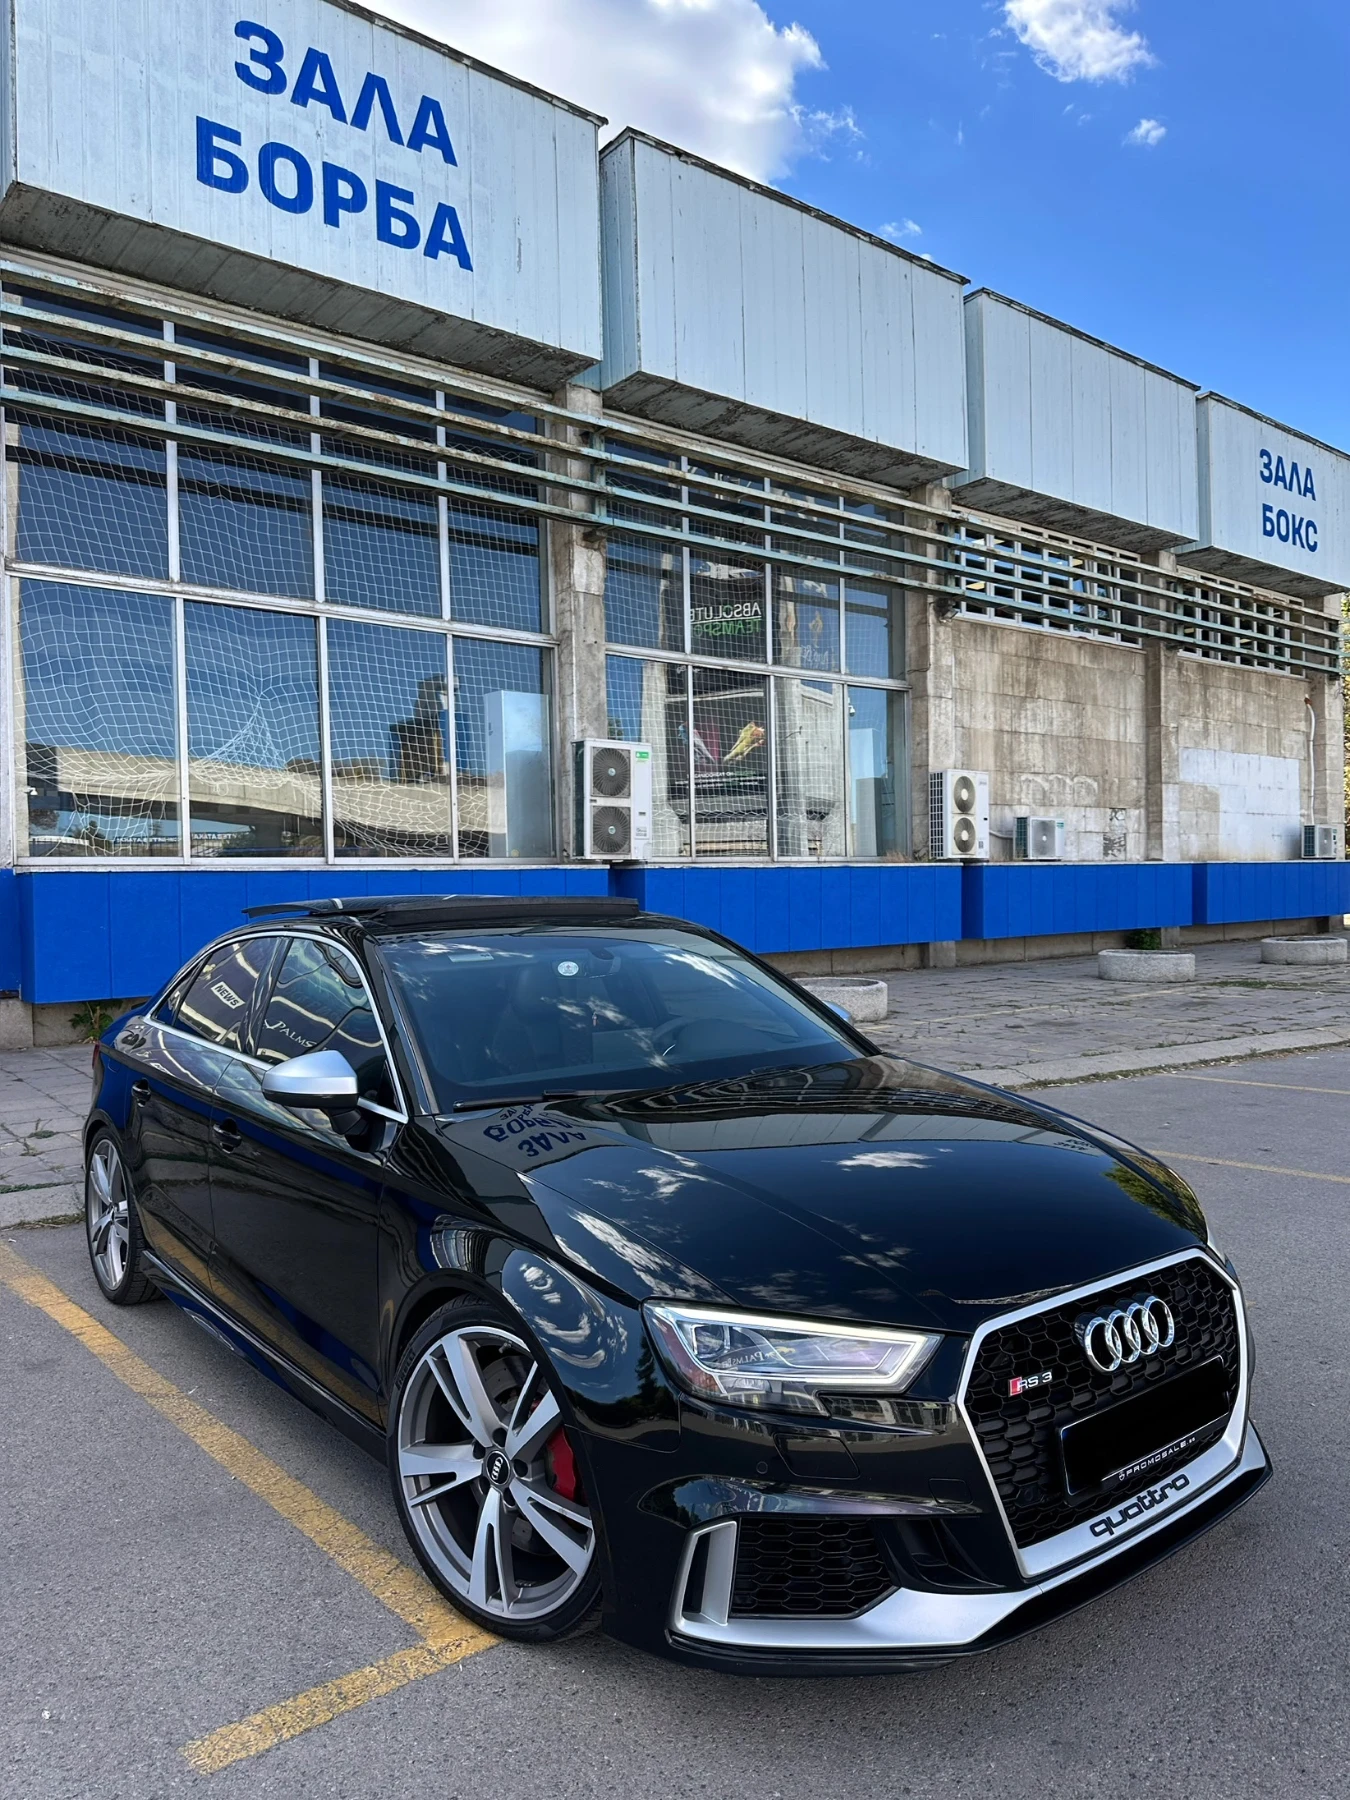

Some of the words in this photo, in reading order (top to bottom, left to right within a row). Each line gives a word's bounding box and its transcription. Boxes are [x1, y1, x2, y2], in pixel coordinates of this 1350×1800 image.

[234, 20, 458, 167] ЗАЛА
[196, 115, 473, 272] БОРБА
[1260, 448, 1316, 501] ЗАЛА
[1262, 503, 1318, 553] БОКС
[214, 983, 240, 1007] NEWS
[1016, 1375, 1039, 1392] RS
[1042, 1371, 1052, 1383] 3
[1089, 1473, 1190, 1538] quattro
